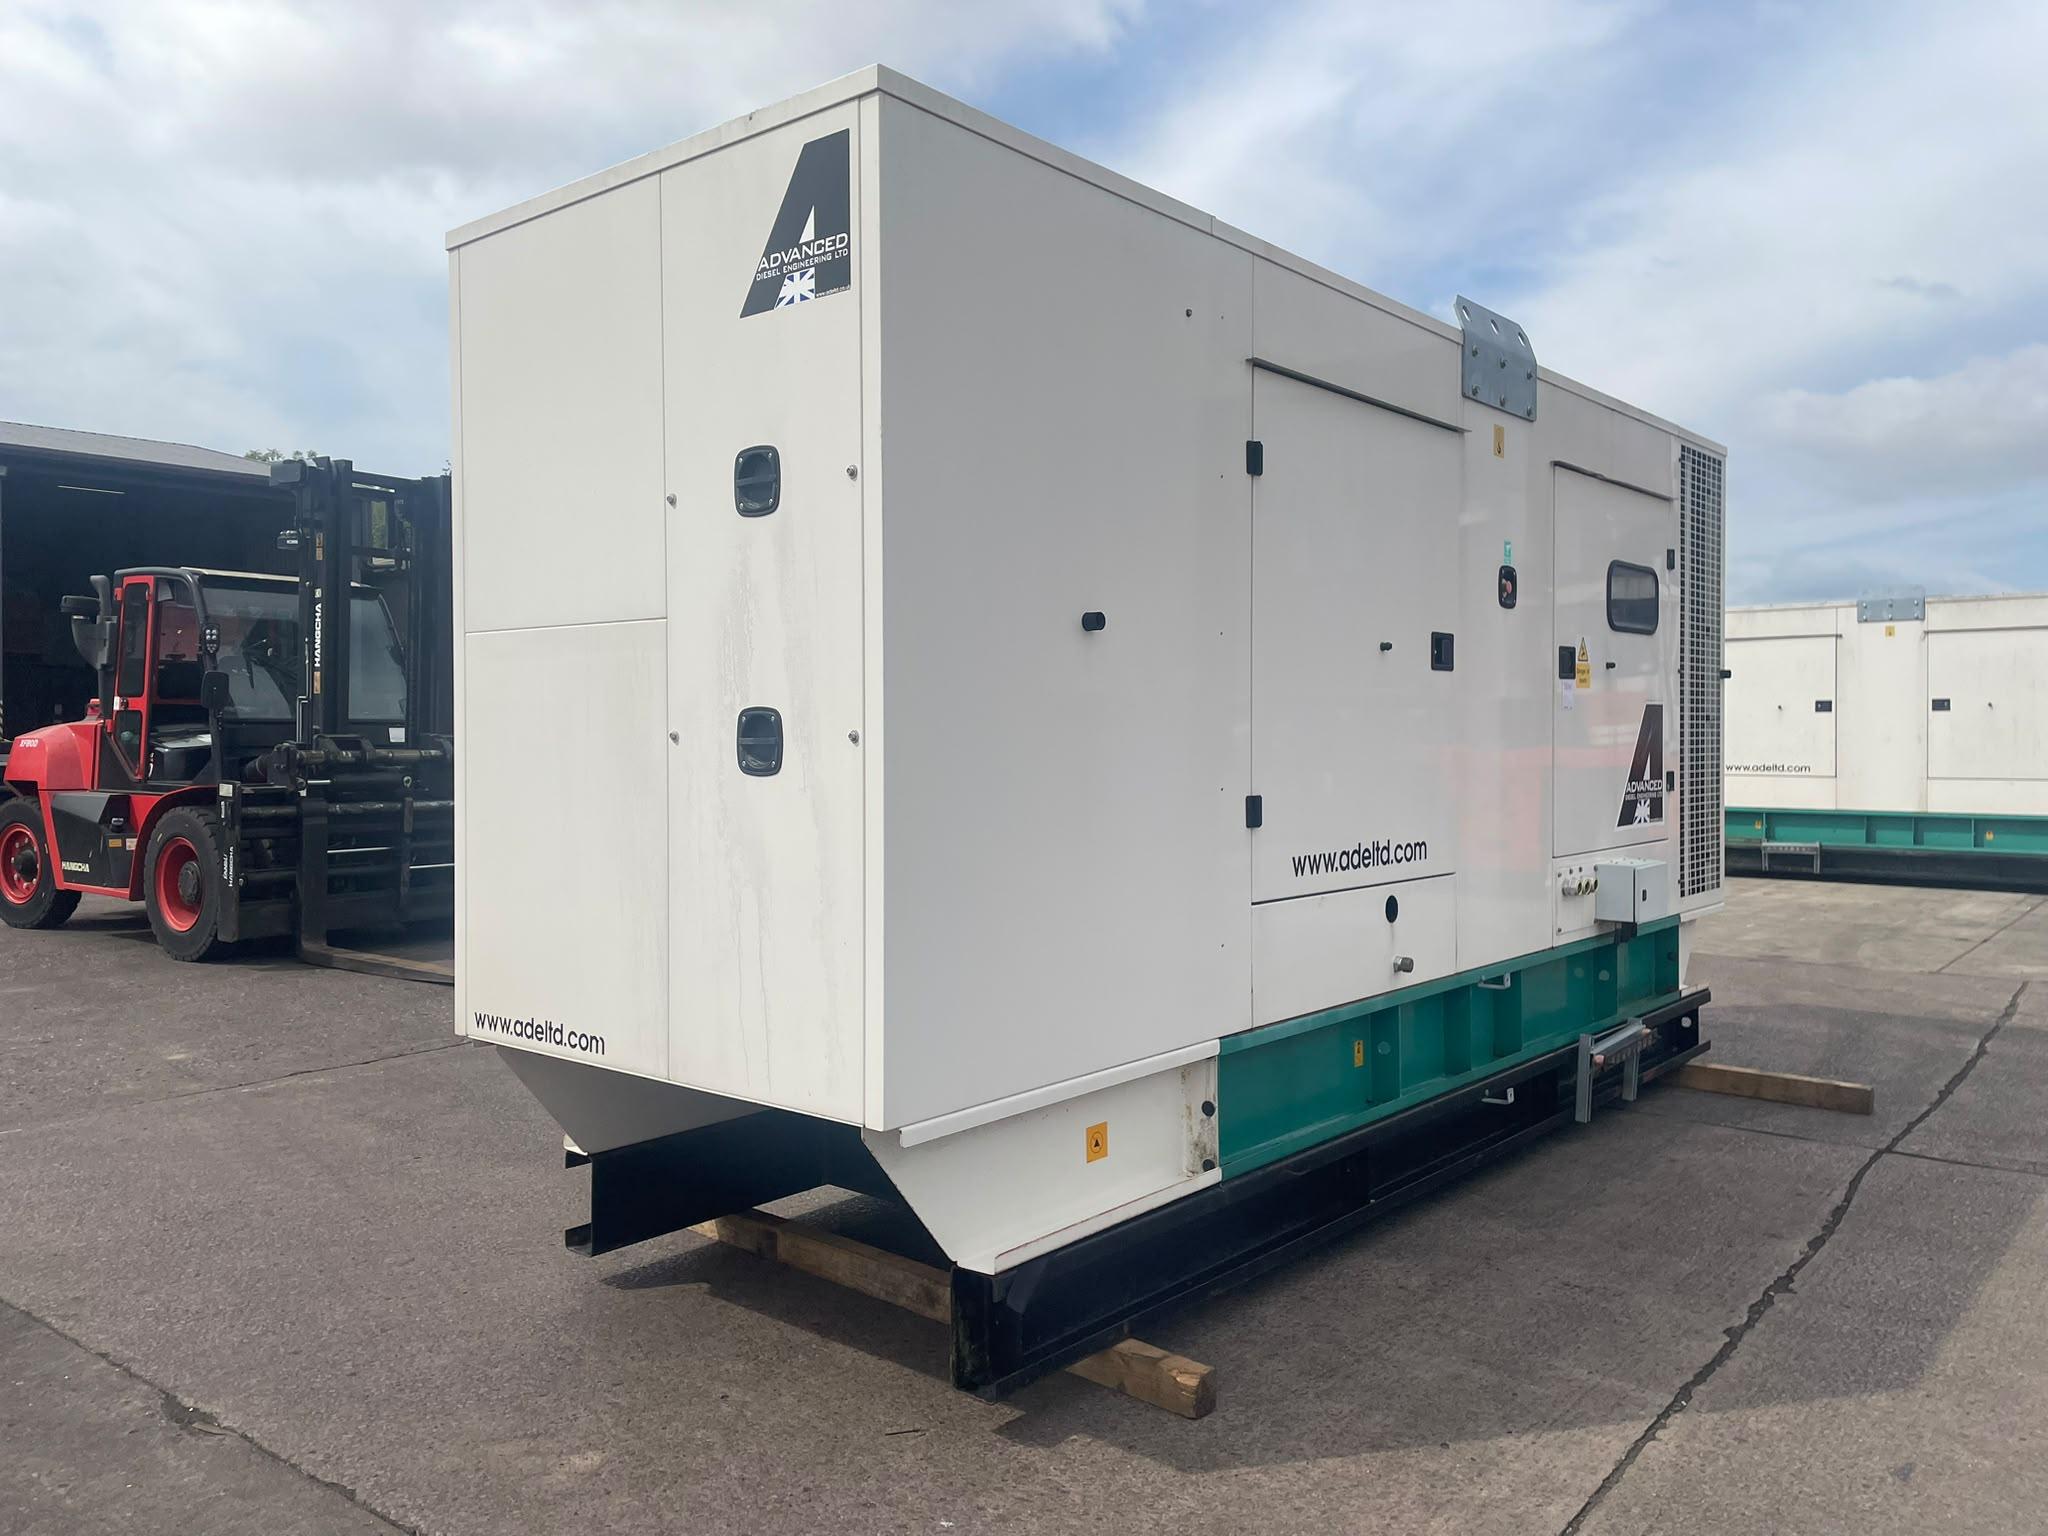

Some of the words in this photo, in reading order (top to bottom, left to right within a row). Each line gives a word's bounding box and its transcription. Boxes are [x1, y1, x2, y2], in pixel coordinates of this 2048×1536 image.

[756, 268, 781, 281] DIESEL
[783, 252, 832, 273] ENGINEERING
[834, 248, 848, 259] LTD
[758, 233, 848, 272] ADVANCED
[313, 603, 322, 667] HANGCHA
[1725, 763, 1811, 773] www.adeltd.com
[1626, 780, 1663, 793] ADVANCED
[61, 861, 90, 872] HANGCHA
[1292, 839, 1427, 877] www.adeltd.com
[474, 1012, 605, 1055] www.adeltd.com
